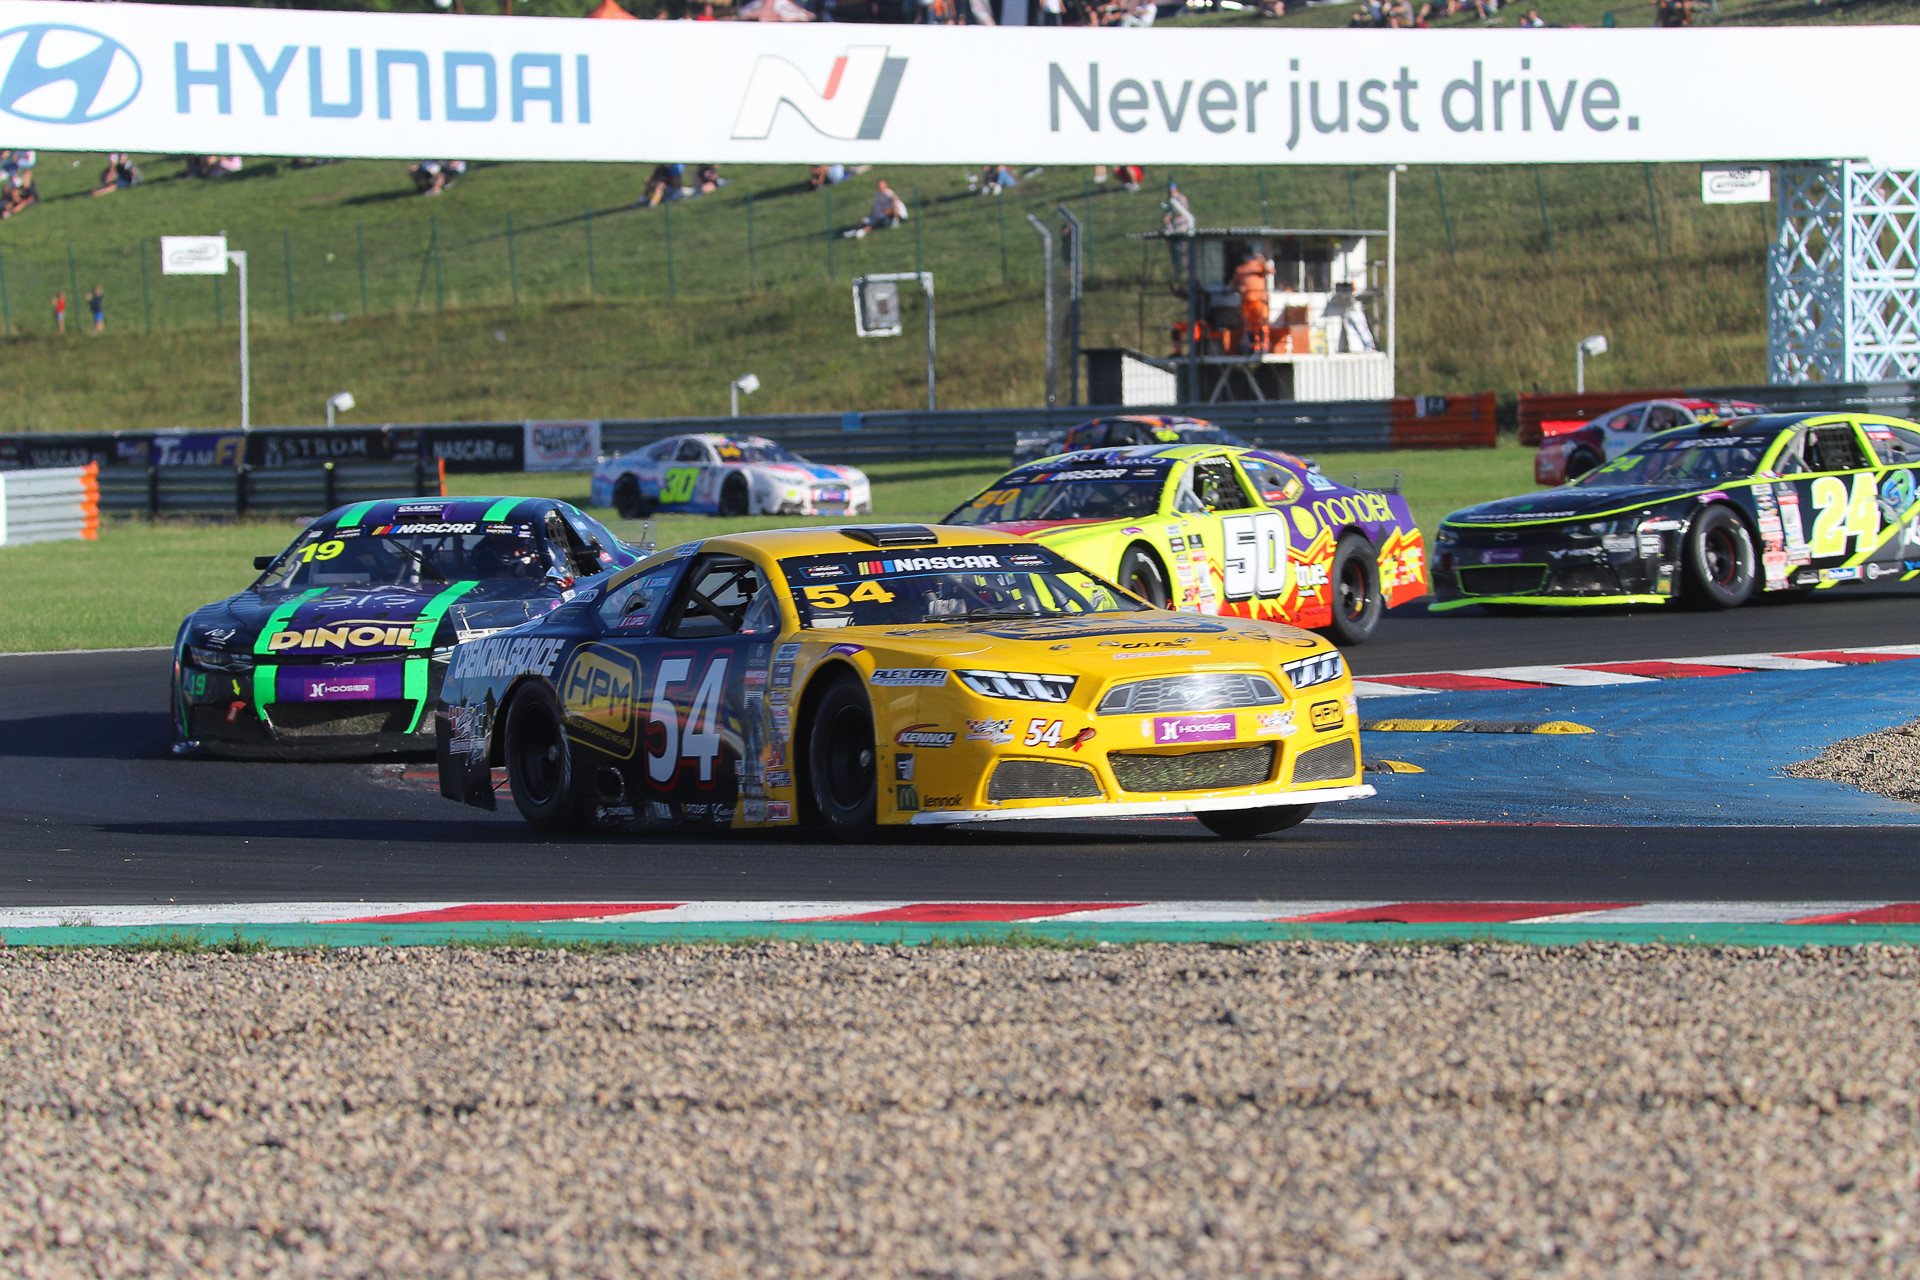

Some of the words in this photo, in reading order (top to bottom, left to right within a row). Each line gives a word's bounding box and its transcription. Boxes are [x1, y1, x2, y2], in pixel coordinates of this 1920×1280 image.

[174, 41, 592, 125] HYUNDAI
[1048, 61, 1268, 134] Never
[1286, 58, 1419, 151] just
[1440, 57, 1641, 132] drive.
[1050, 469, 1129, 481] NASCAR
[1599, 455, 1646, 473] 24
[659, 466, 699, 504] 30
[972, 487, 1022, 509] 50
[1810, 471, 1882, 558] 24
[396, 523, 477, 535] NASCAR
[298, 540, 345, 563] 19
[895, 555, 1002, 572] NASCAR
[1221, 510, 1289, 602] 50
[802, 580, 896, 609] 54
[267, 626, 416, 651] DINOIL
[188, 674, 207, 696] 19
[324, 684, 370, 694] HOOSIER
[567, 659, 631, 723] HPM
[647, 656, 730, 784] 54
[1179, 722, 1232, 734] HOOSIER
[898, 732, 956, 744] KENNOL
[1024, 717, 1064, 748] 54
